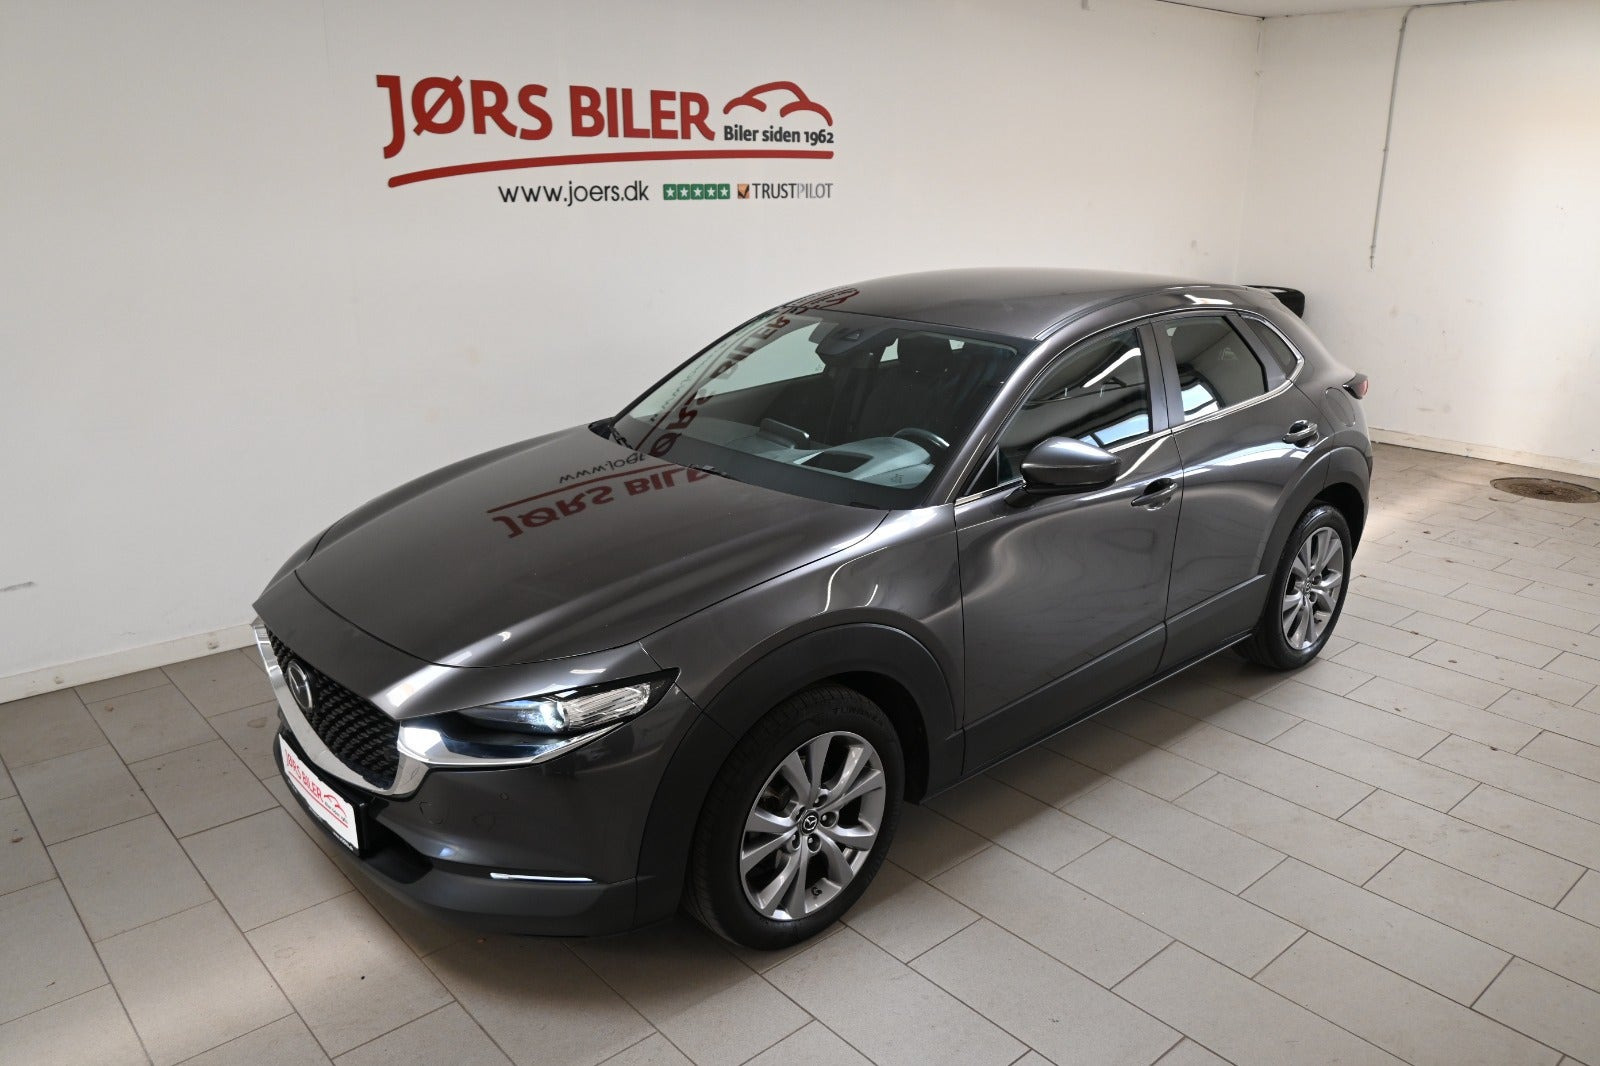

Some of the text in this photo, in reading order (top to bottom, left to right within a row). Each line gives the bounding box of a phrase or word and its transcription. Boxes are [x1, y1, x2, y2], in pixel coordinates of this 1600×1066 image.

[377, 74, 716, 158] JØRS BILER
[723, 125, 835, 146] Biler siden 1962
[498, 180, 650, 207] www.joers.dk
[751, 182, 834, 200] TRUSTPILOT
